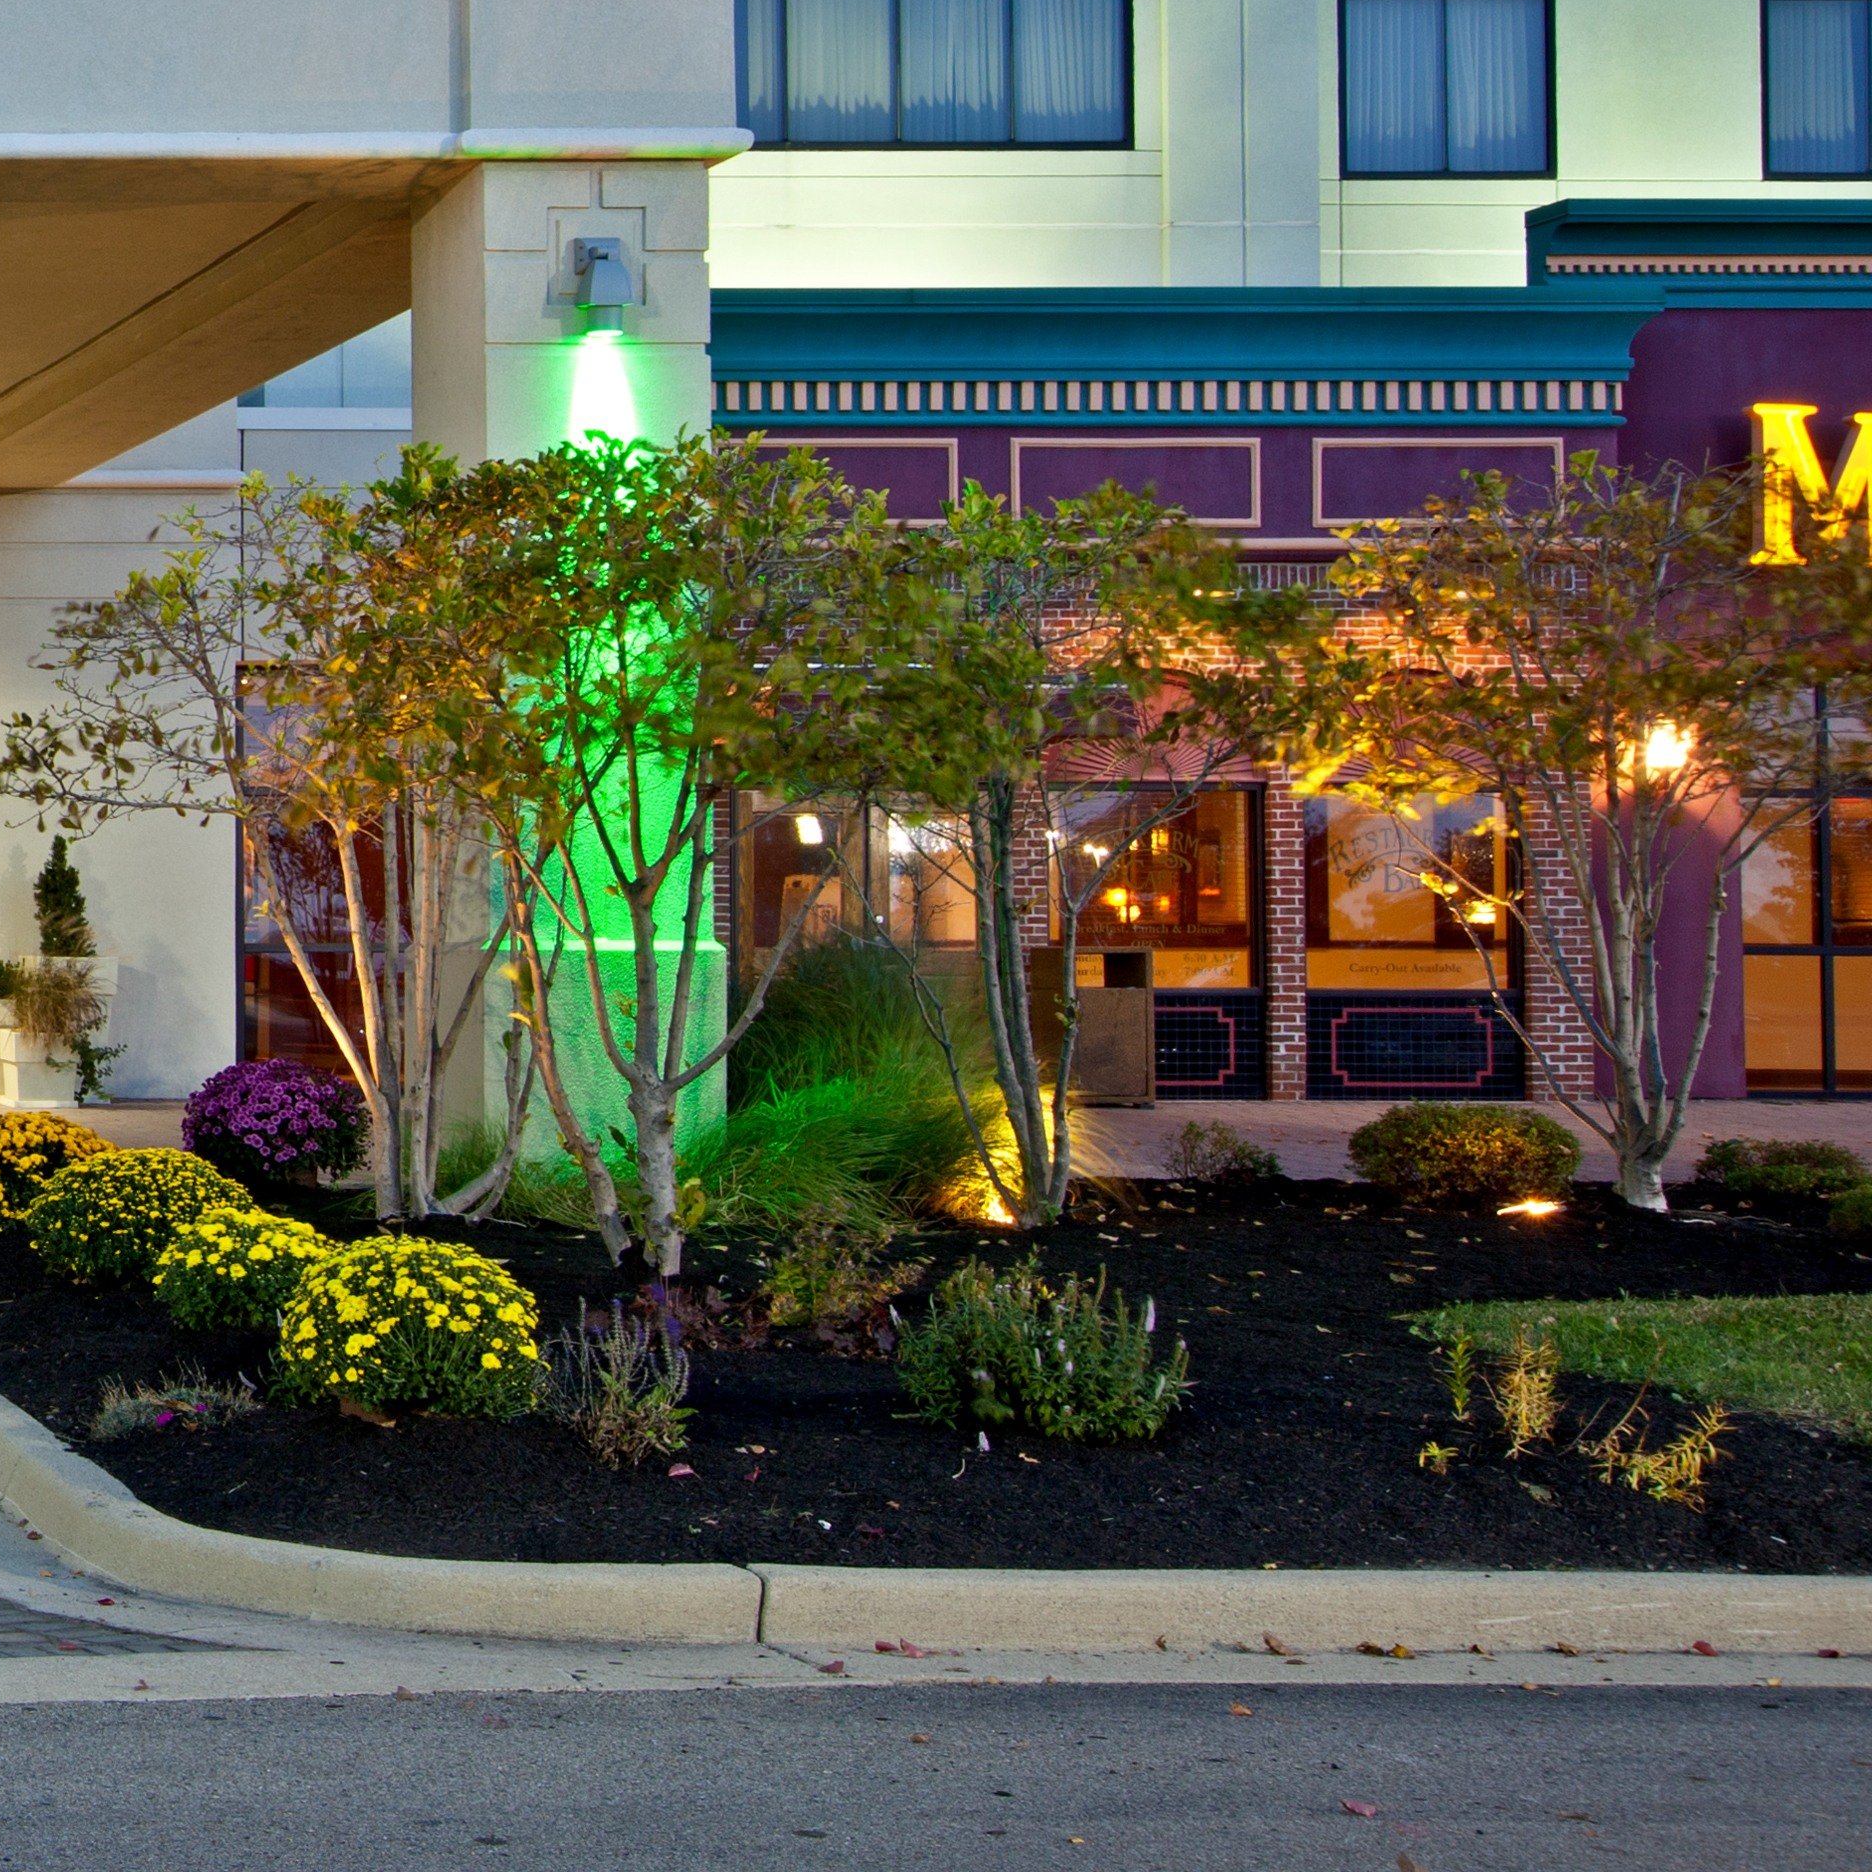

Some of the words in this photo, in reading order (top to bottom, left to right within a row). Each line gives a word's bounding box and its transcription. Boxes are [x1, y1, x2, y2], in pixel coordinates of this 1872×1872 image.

[1750, 403, 1872, 567] M
[1186, 924, 1225, 935] Dinner
[1348, 963, 1408, 976] Carry-Out
[1411, 963, 1462, 974] Available
